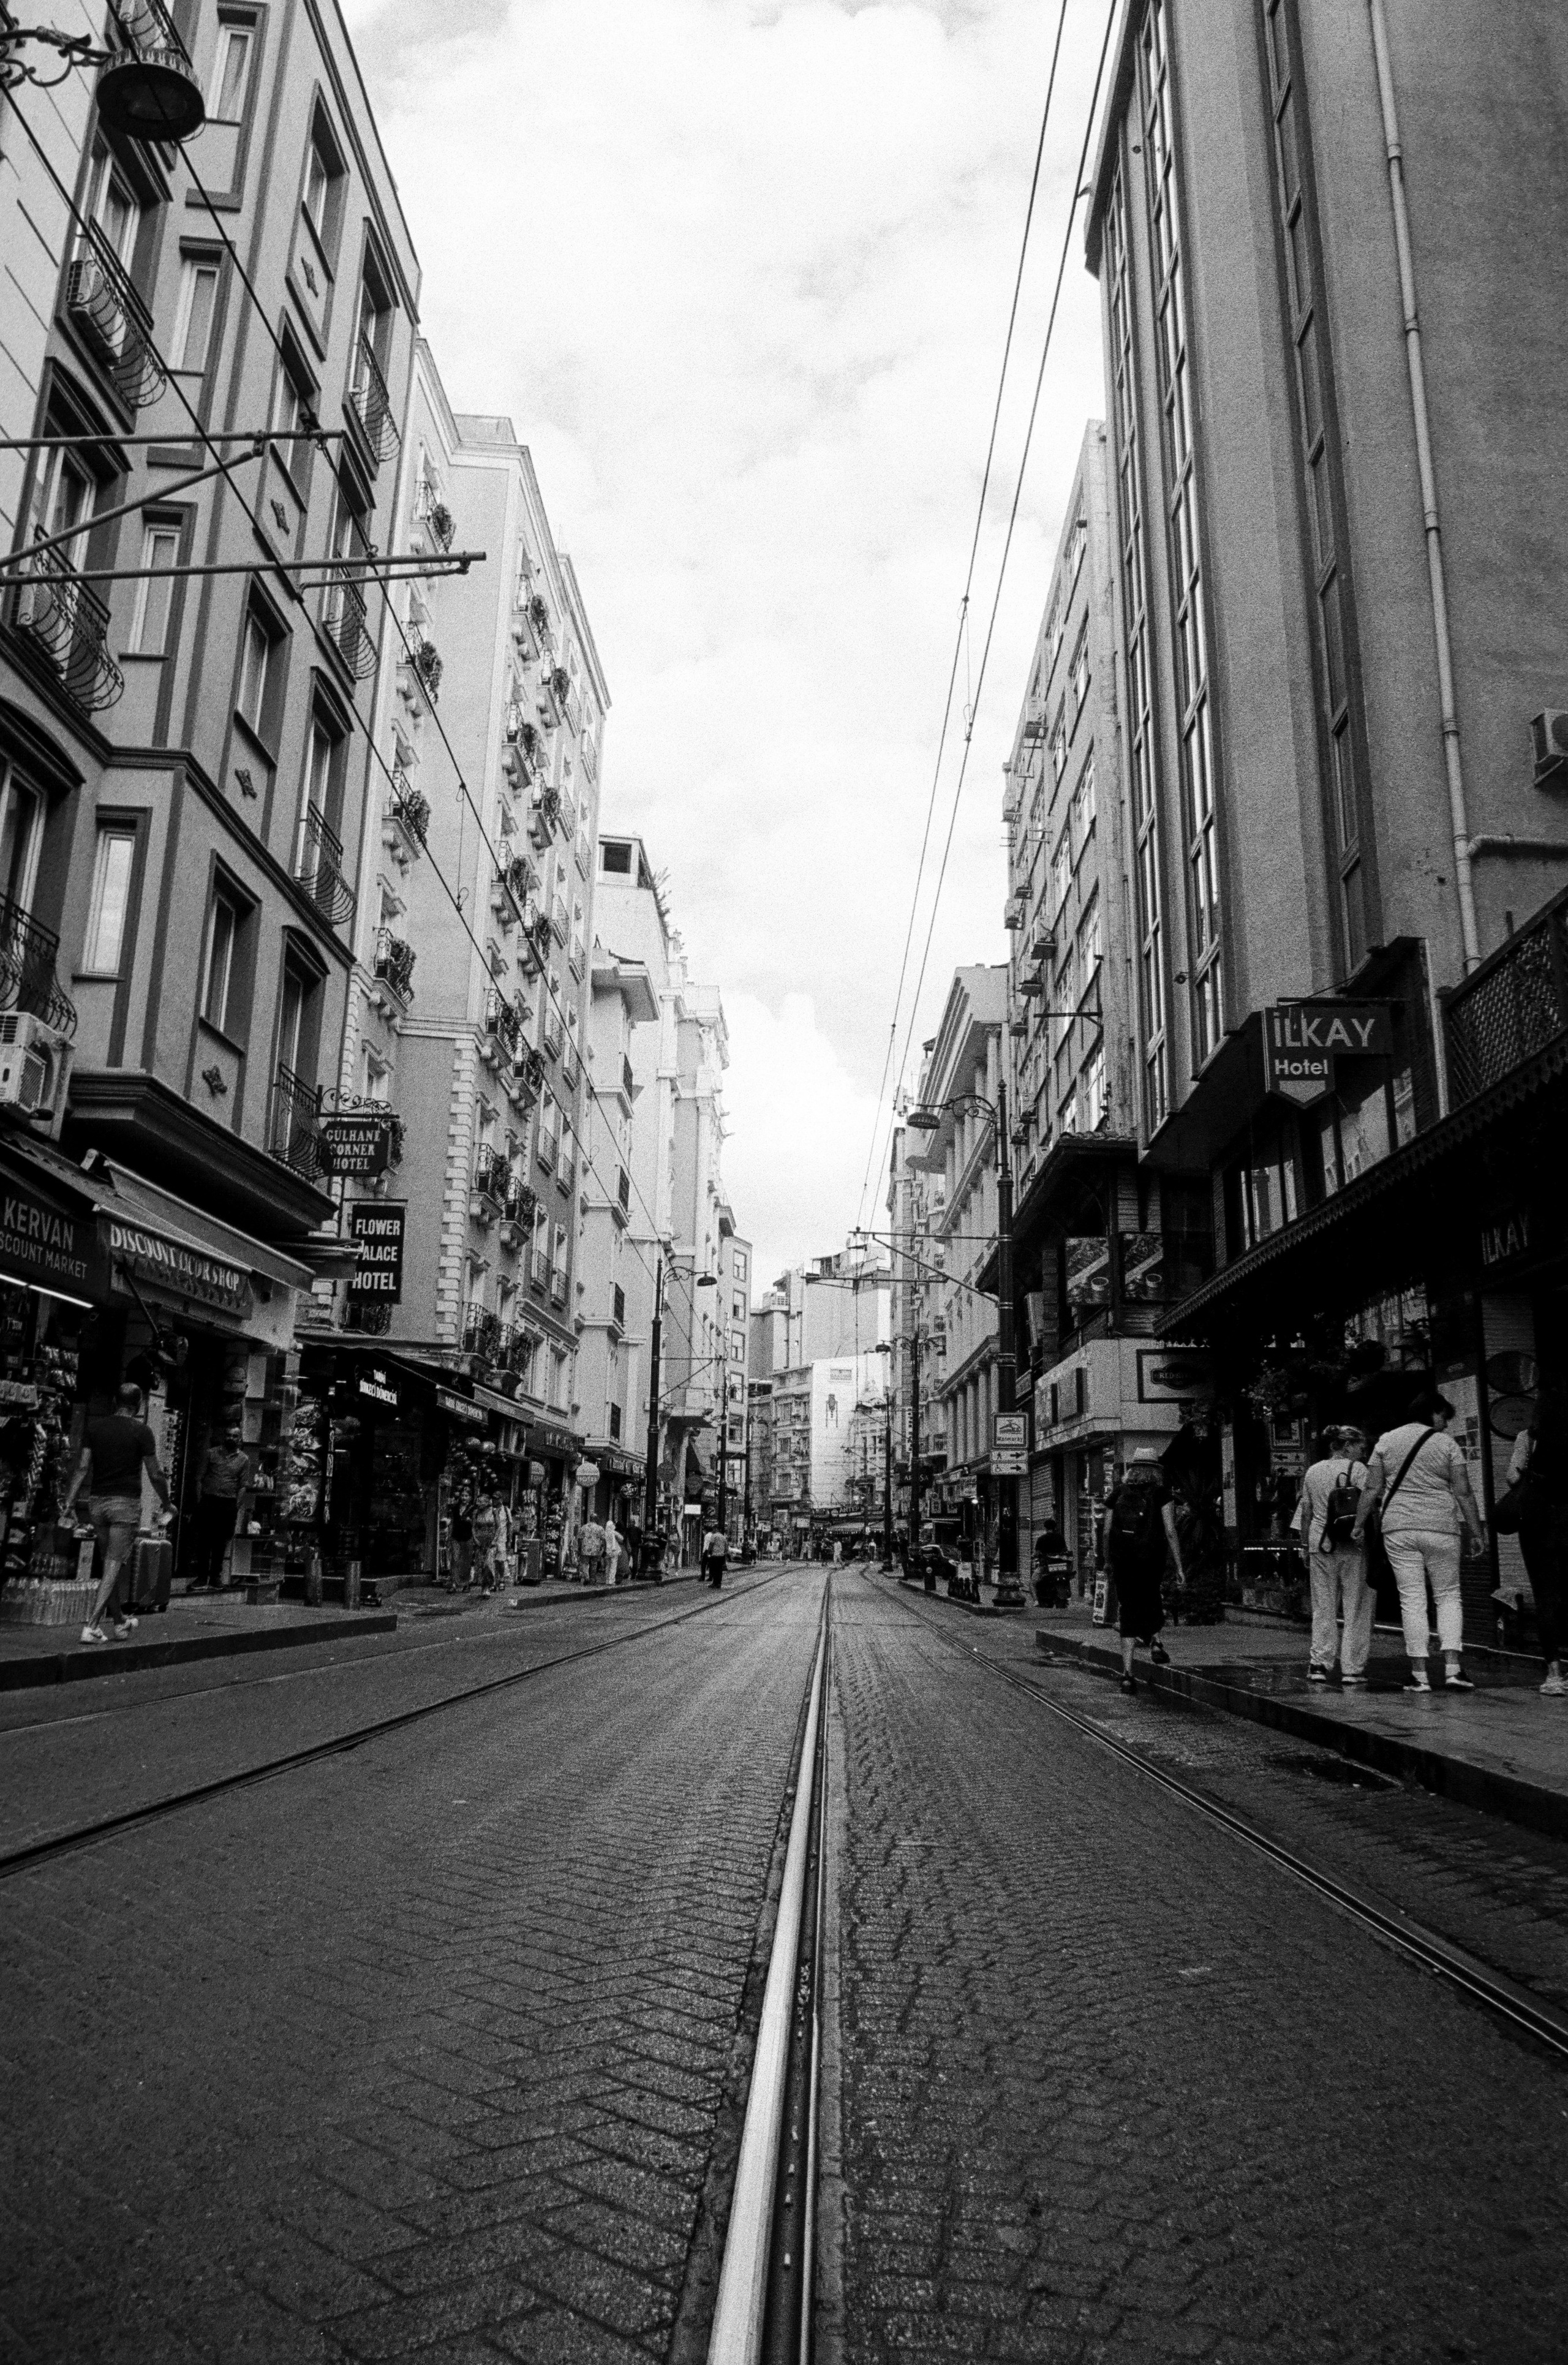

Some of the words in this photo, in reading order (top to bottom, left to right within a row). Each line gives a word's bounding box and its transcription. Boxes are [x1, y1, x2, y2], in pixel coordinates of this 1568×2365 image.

[1273, 1012, 1376, 1047] İLKAY
[1275, 1058, 1329, 1076] Hotel
[326, 1126, 381, 1142] GÜLHANE
[330, 1144, 375, 1156] CORNER
[333, 1157, 370, 1170] HOTEL
[4, 1196, 74, 1252] KERVAN
[355, 1219, 401, 1235] FLOWER
[45, 1248, 87, 1280] MARKET
[110, 1224, 176, 1267] DISCOUNT
[212, 1265, 239, 1291] SHOP
[352, 1272, 396, 1290] HOTEL
